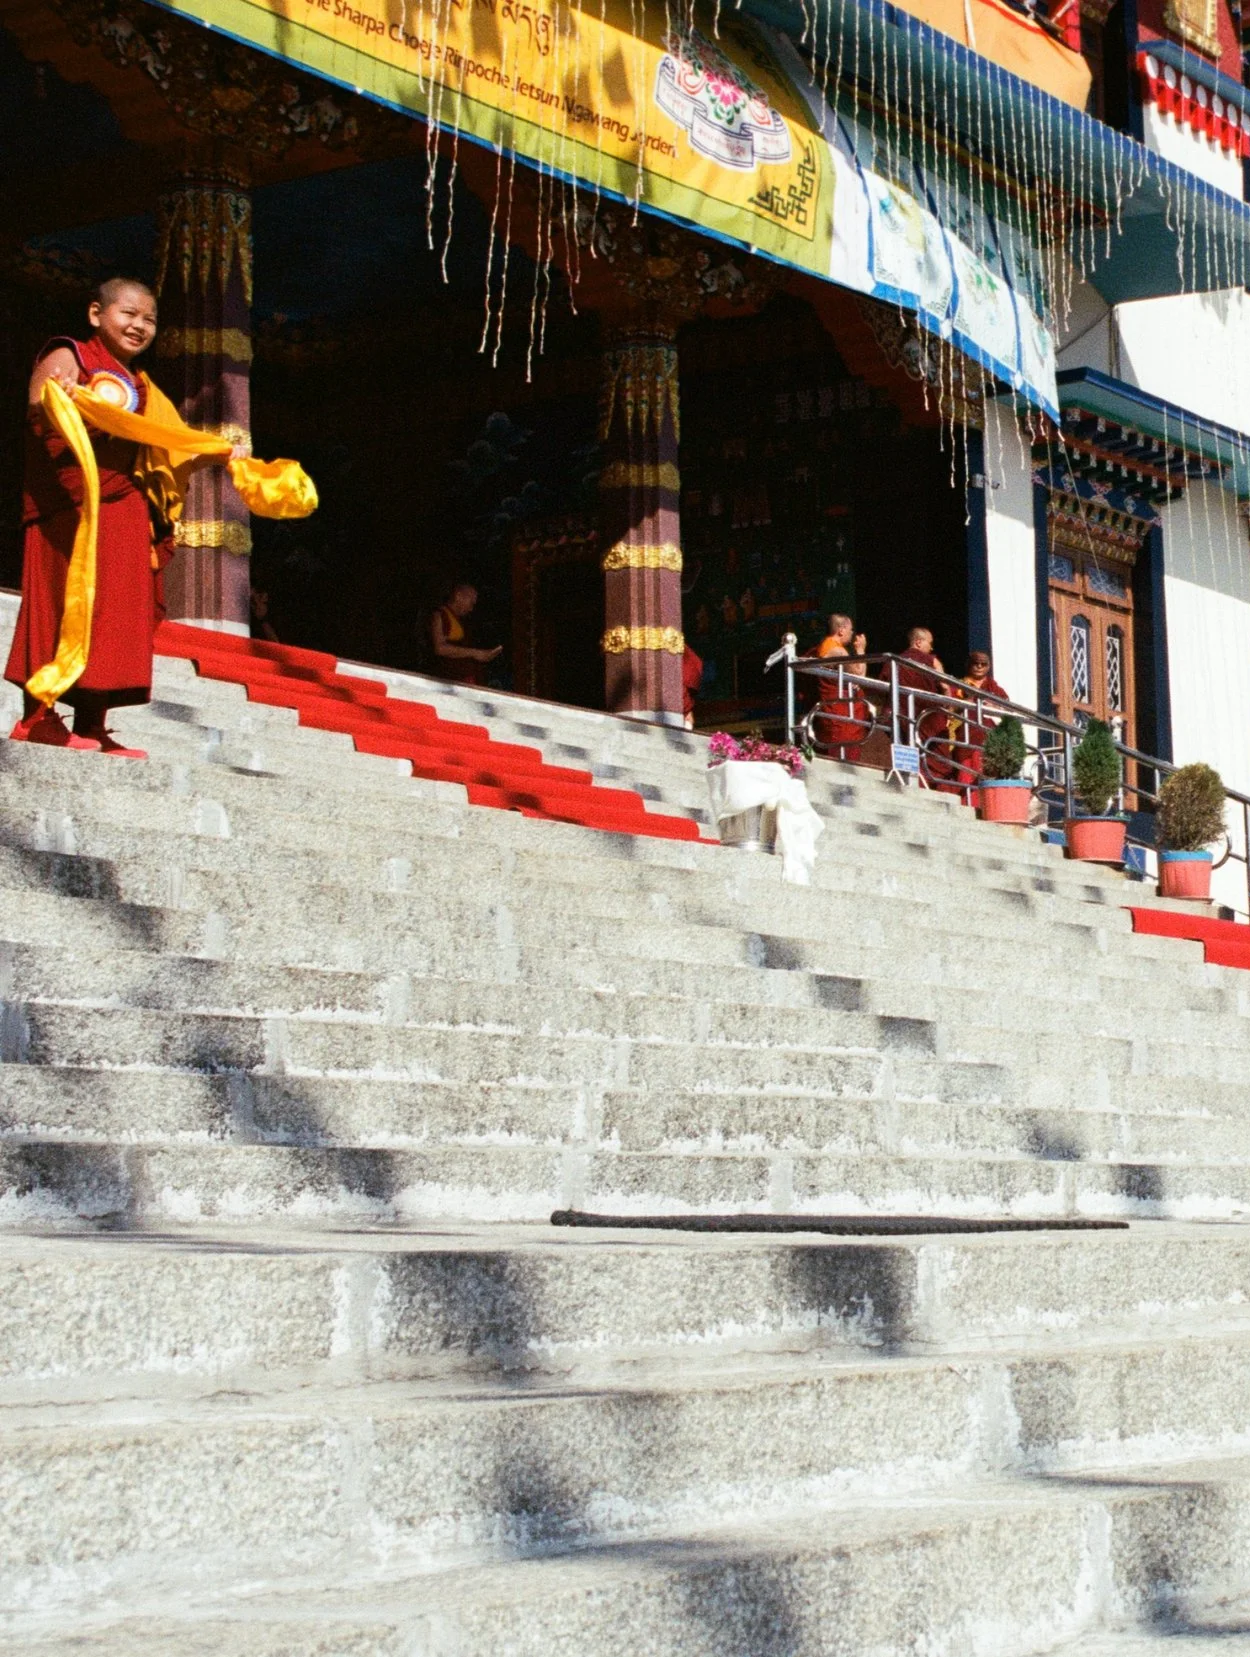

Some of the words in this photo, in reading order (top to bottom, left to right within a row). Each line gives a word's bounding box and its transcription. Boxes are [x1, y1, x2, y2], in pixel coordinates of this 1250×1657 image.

[333, 0, 385, 36] Sharpa
[388, 23, 441, 60] Choeje
[444, 45, 510, 89] Rinpoche
[561, 95, 629, 143] Ngawang
